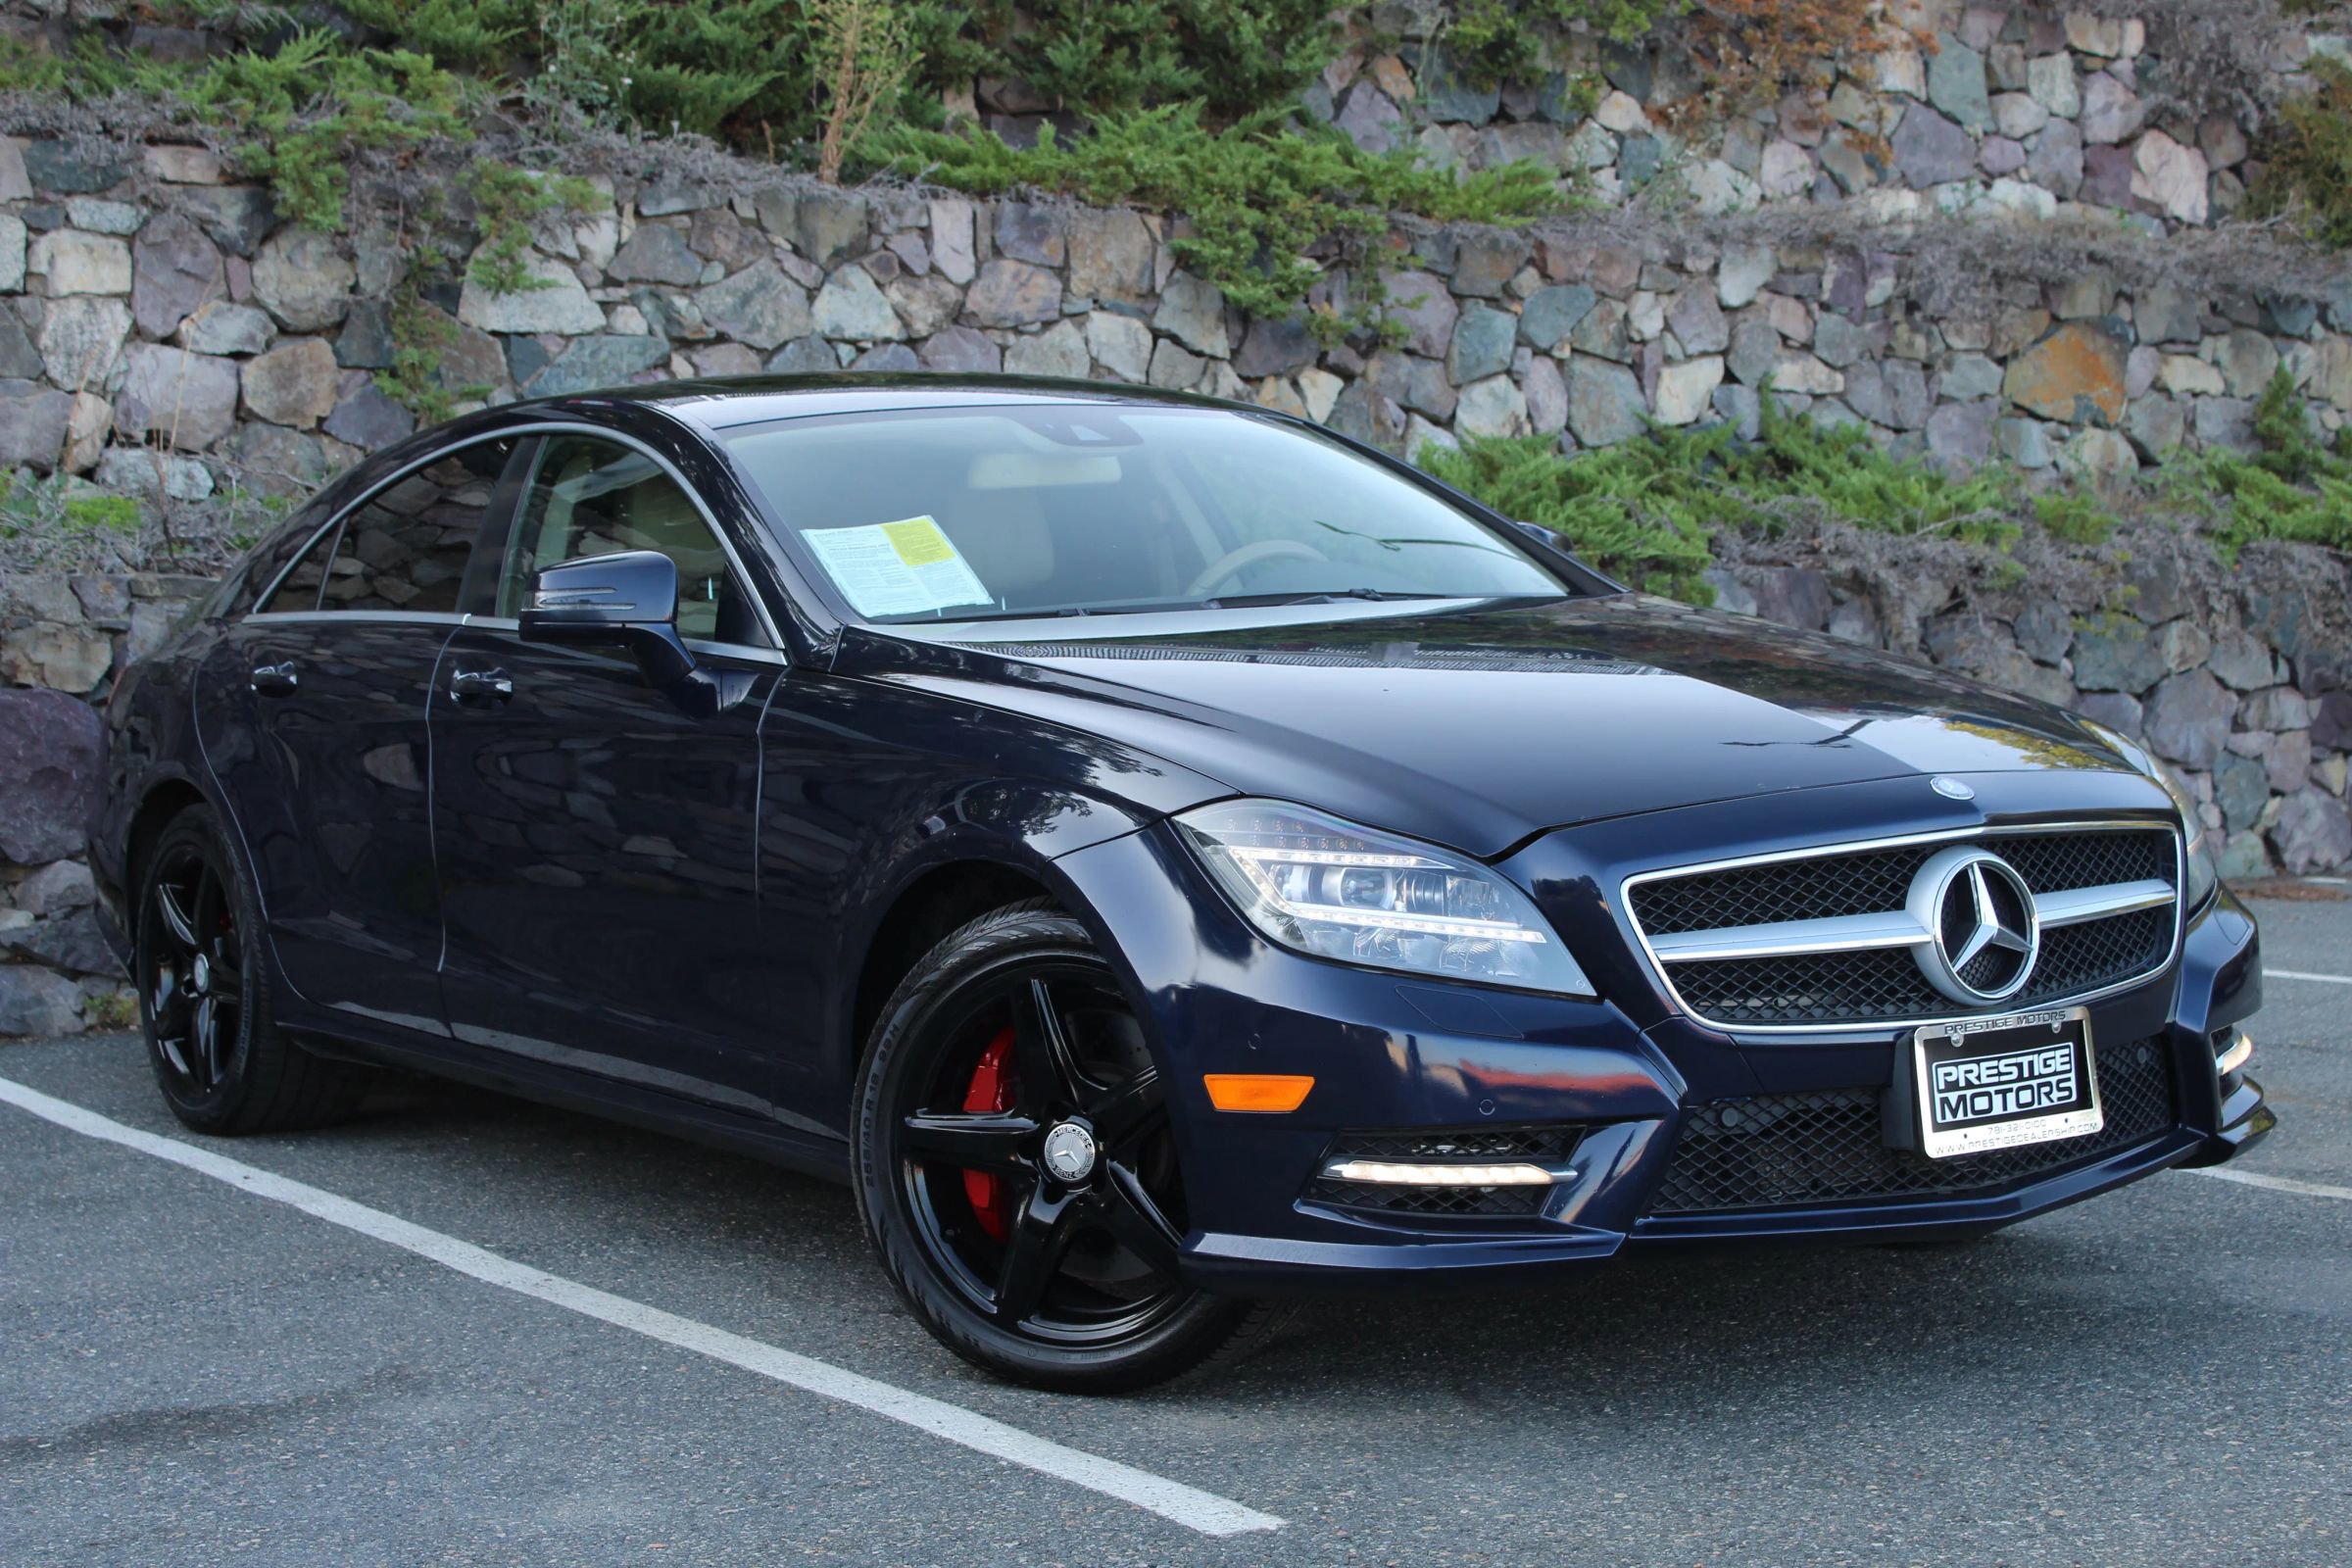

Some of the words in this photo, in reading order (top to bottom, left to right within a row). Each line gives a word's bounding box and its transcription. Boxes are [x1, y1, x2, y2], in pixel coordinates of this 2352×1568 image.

[1944, 1018, 2013, 1034] PRESTIGE
[2017, 1010, 2066, 1025] MOTORS
[1938, 1049, 2071, 1090] PRESTIGE
[1940, 1078, 2073, 1120] MOTORS
[1055, 1126, 1091, 1147] MERCEDES
[1054, 1168, 1074, 1179] BENZ
